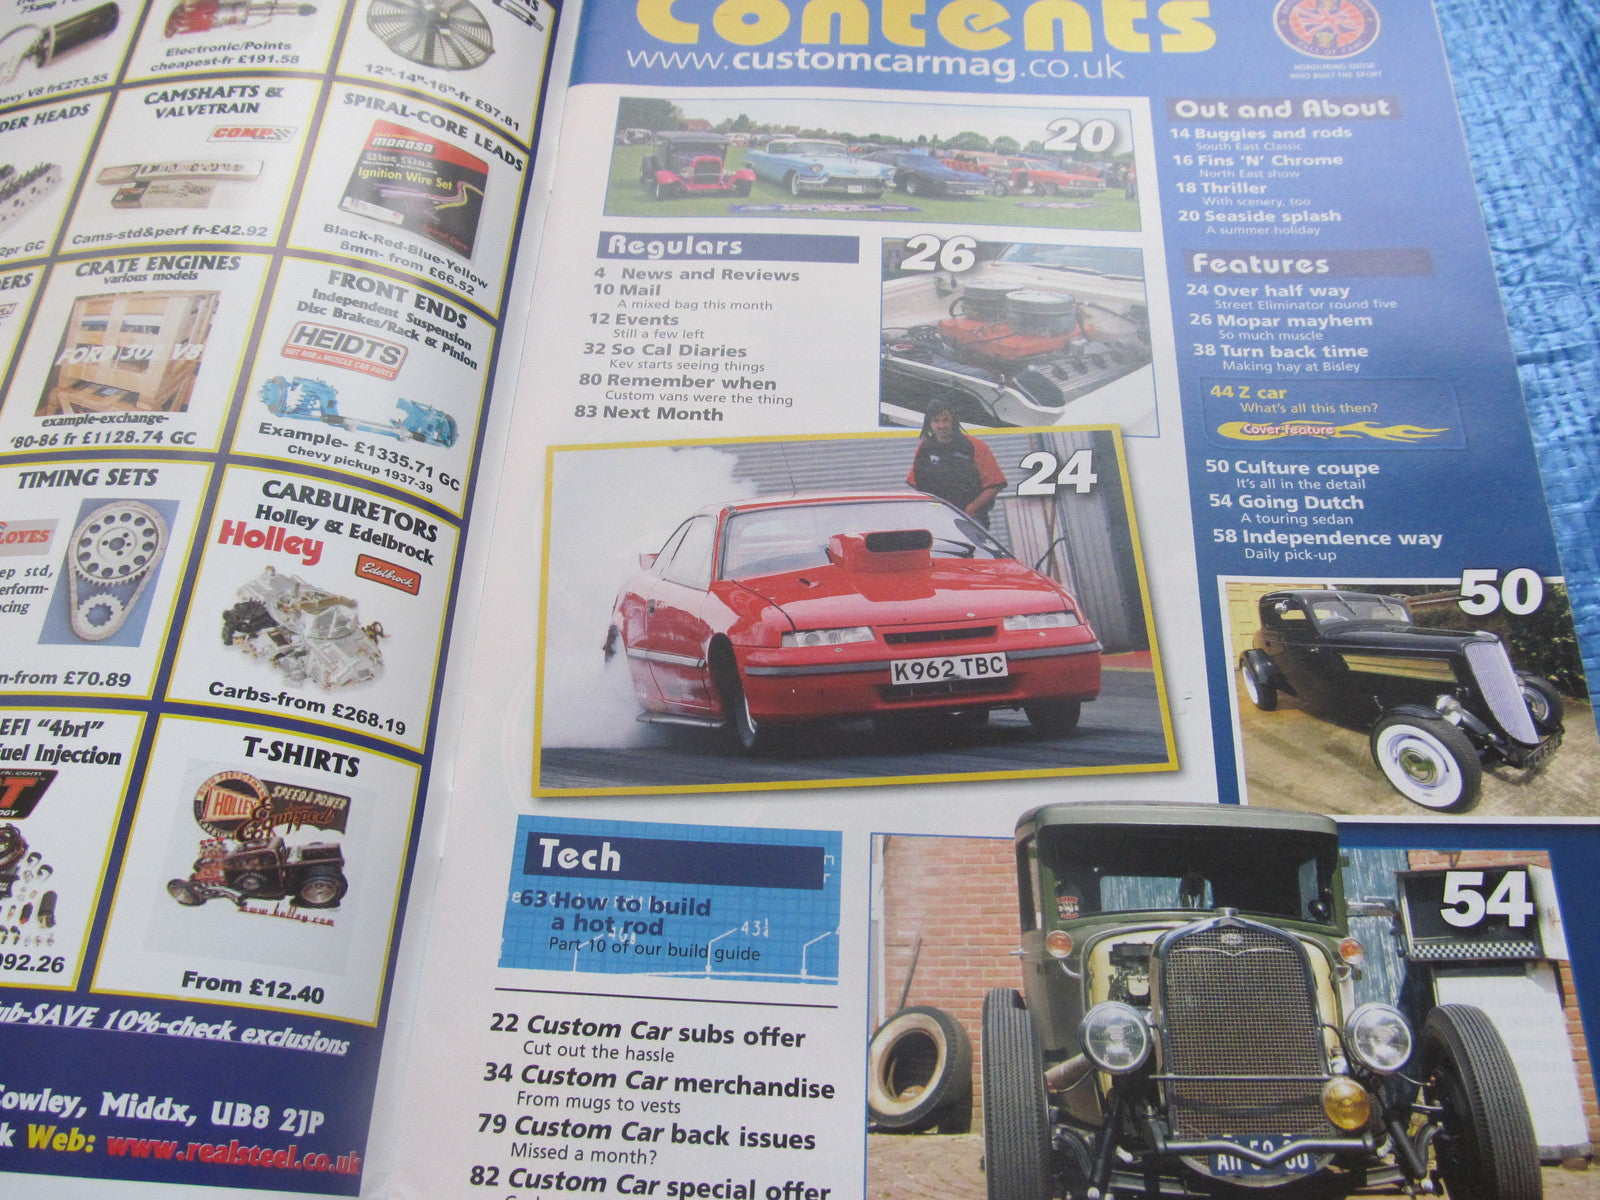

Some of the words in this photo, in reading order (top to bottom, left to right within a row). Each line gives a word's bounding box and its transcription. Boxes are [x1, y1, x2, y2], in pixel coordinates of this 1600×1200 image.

[636, 0, 1217, 53] Contents
[165, 41, 292, 57] Electronic/Points
[151, 57, 233, 72] cheapest-fr
[238, 54, 300, 64] £191.58
[626, 48, 1126, 83] www.customcarmag.co.uk
[144, 85, 260, 105] CAMSHAFTS
[265, 87, 284, 98] &
[155, 102, 260, 119] VALVETRAIN
[1175, 100, 1229, 118] Out
[1238, 100, 1292, 119] and
[1302, 99, 1390, 118] About
[343, 92, 468, 139] SPIRAL-CORE
[474, 132, 523, 172] LEADS
[1043, 118, 1116, 152] 20
[1170, 128, 1190, 139] 14
[1195, 128, 1266, 142] Buggies
[1273, 128, 1306, 139] and
[1312, 127, 1352, 138] rods
[1173, 155, 1193, 166] 16
[1198, 155, 1234, 166] Fins
[1271, 154, 1343, 166] Chrome
[357, 166, 402, 180] Ignition
[406, 171, 432, 185] Wire
[436, 177, 453, 190] Set
[1176, 182, 1197, 194] 18
[1201, 182, 1268, 194] Thriller
[1178, 210, 1200, 222] 20
[1204, 210, 1276, 222] Seaside
[1282, 209, 1342, 224] splash
[72, 225, 188, 245] Cams-std&perf
[192, 225, 268, 237] fr-£42.92
[323, 223, 488, 289] Black-Red-Blue-Yellow
[608, 235, 743, 259] Regulars
[900, 233, 977, 272] 26
[75, 258, 140, 277] CRATE
[146, 255, 241, 271] ENGINES
[339, 240, 384, 259] 8mm-
[388, 253, 425, 272] from
[429, 266, 475, 295] £66.52
[594, 266, 606, 278] 4
[622, 268, 673, 280] News
[680, 268, 715, 280] and
[721, 268, 800, 282] Reviews
[1193, 253, 1330, 274] Features
[103, 272, 148, 284] various
[152, 272, 199, 281] models
[594, 283, 615, 295] 10
[619, 284, 661, 296] Mail
[327, 270, 410, 302] FRONT
[414, 294, 468, 330] ENDS
[1186, 284, 1208, 296] 24
[1214, 284, 1258, 297] Over
[1265, 284, 1303, 297] half
[1310, 286, 1350, 299] way
[1215, 300, 1253, 310] Street
[1258, 300, 1325, 310] Eliminator
[1329, 299, 1369, 310] round
[1373, 299, 1398, 309] five
[312, 288, 400, 318] Independent
[405, 313, 472, 352] Suspension
[589, 313, 610, 325] 12
[615, 313, 679, 326] Events
[293, 325, 401, 366] HEIDTS
[297, 300, 328, 316] Disc
[332, 307, 420, 341] Brakes/Rack
[424, 336, 437, 348] &
[441, 342, 478, 370] Pinion
[583, 342, 606, 355] 32
[611, 343, 635, 355] So
[642, 343, 672, 356] Cal
[679, 344, 747, 358] Diaries
[609, 359, 634, 369] Kev
[638, 359, 673, 370] starts
[677, 360, 720, 372] seeing
[724, 361, 765, 374] things
[1210, 385, 1235, 398] 44
[1239, 386, 1250, 399] Z
[1257, 387, 1287, 399] car
[41, 413, 169, 427] example-exchange-
[574, 405, 598, 418] 83
[603, 406, 651, 420] Next
[657, 407, 724, 422] Month
[1290, 403, 1306, 413] all
[1311, 403, 1336, 414] this
[1340, 403, 1378, 414] then?
[64, 431, 78, 445] fr
[82, 430, 164, 445] £1128.74
[170, 431, 197, 445] GC
[1243, 423, 1281, 436] Cover
[1284, 423, 1335, 436] feature
[258, 422, 349, 449] Example-
[354, 441, 434, 478] £1335.71
[439, 472, 461, 492] GC
[1205, 459, 1229, 473] 50
[1235, 460, 1310, 475] Culture
[1317, 463, 1380, 477] coupe
[18, 469, 99, 489] TIMING
[105, 468, 160, 486] SETS
[287, 445, 331, 462] Chevy
[334, 454, 381, 476] pickup
[384, 468, 434, 493] 1937-39
[1017, 449, 1098, 496] 24
[262, 479, 439, 543] CARBURETORS
[217, 519, 324, 566] Holley
[255, 504, 320, 530] Holley
[324, 521, 343, 535] &
[349, 523, 434, 566] Edelbrock
[1213, 529, 1238, 543] 58
[1243, 529, 1392, 548] Independence
[1398, 534, 1443, 549] way
[1244, 549, 1280, 562] Daily
[1285, 549, 1337, 563] pick-up
[361, 561, 414, 589] Edelbrock
[1458, 568, 1543, 616] 50
[63, 671, 132, 688] £70.89
[894, 659, 956, 682] K962
[961, 655, 1005, 677] TBC
[208, 681, 326, 714] Carbs-from
[332, 703, 406, 735] £268.19
[34, 743, 122, 766] Injection
[242, 735, 360, 778] T-SHIRTS
[539, 837, 621, 872] Tech
[519, 889, 548, 908] 63
[554, 891, 607, 912] How
[616, 895, 642, 913] to
[649, 897, 712, 918] build
[1439, 869, 1535, 929] 54
[551, 917, 566, 931] a
[573, 913, 614, 934] hot
[622, 918, 665, 937] rod
[181, 970, 243, 993] From
[249, 978, 325, 1005] £12.40
[104, 1009, 236, 1042] 10%-check
[240, 1028, 351, 1055] exclusions
[489, 1012, 519, 1033] 22
[527, 1014, 622, 1039] Custom
[630, 1020, 673, 1041] Car
[678, 1024, 735, 1045] subs
[743, 1026, 806, 1048] offer
[522, 1041, 552, 1057] Cut
[557, 1042, 586, 1058] out
[591, 1043, 619, 1060] the
[625, 1046, 675, 1063] hassle
[99, 1091, 198, 1127] Middx,
[211, 1101, 270, 1129] UB8
[279, 1108, 325, 1136] 2JP
[27, 1123, 96, 1153] Web:
[106, 1136, 362, 1175] www.realsteel.co.uk
